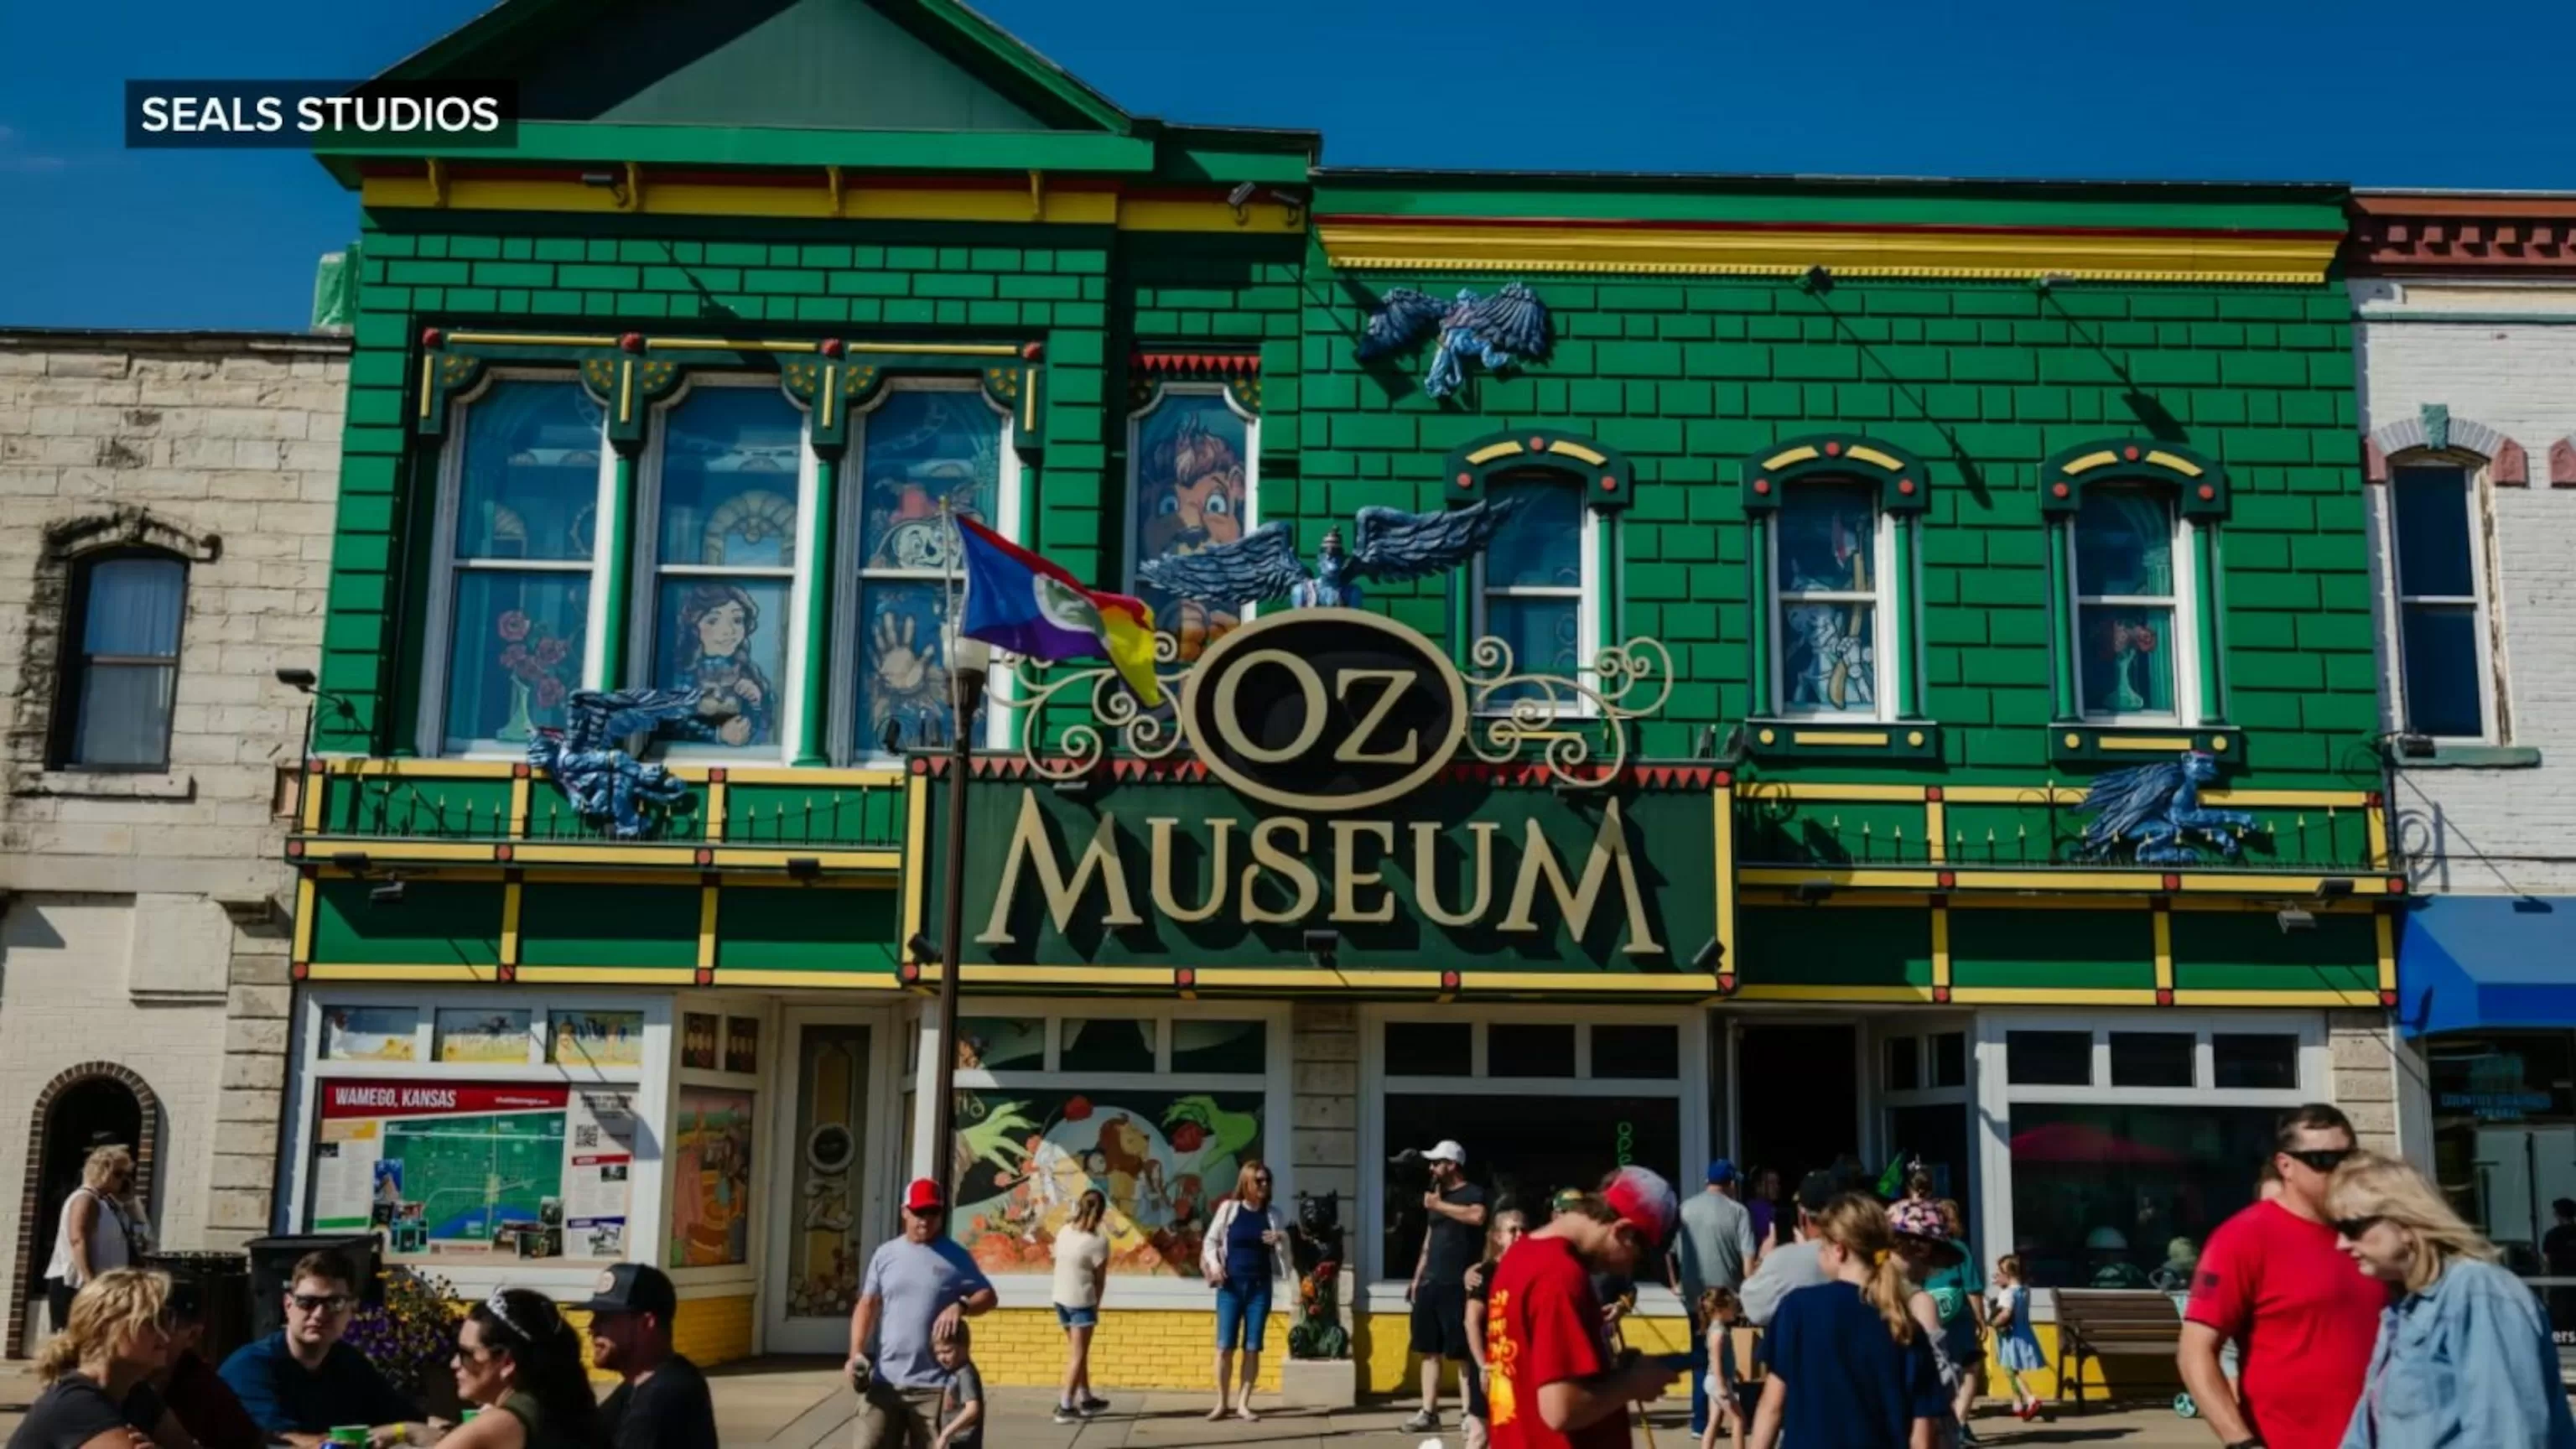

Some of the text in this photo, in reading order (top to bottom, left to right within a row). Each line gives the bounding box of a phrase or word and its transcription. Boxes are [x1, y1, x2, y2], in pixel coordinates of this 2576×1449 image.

[1213, 649, 1419, 765] OZ
[975, 787, 1665, 953] MUSEUM
[335, 1087, 457, 1108] WAMEGO, KANSAS
